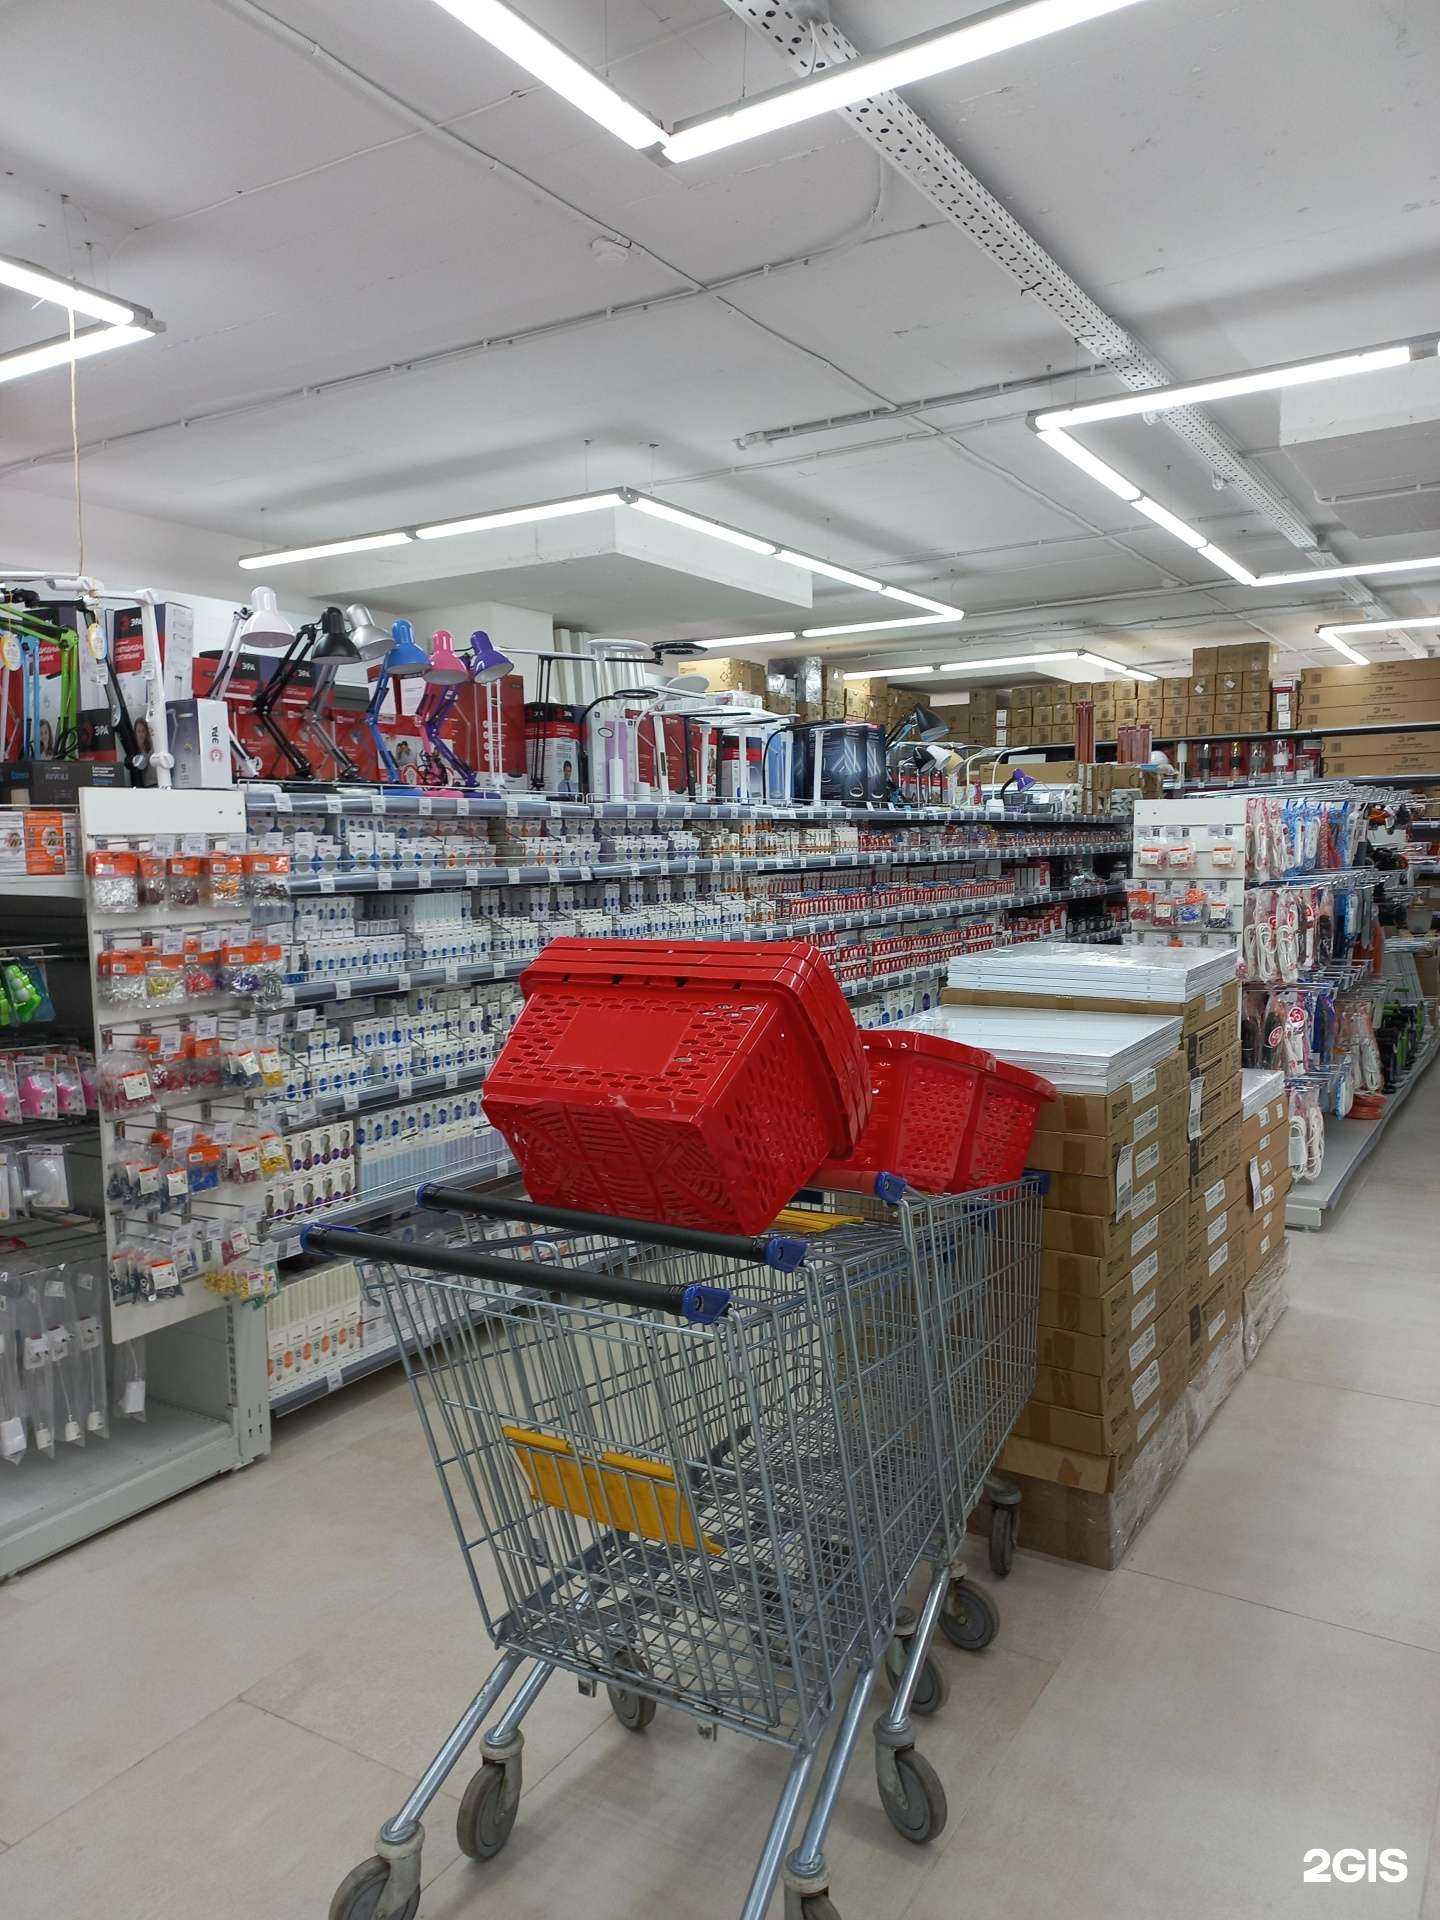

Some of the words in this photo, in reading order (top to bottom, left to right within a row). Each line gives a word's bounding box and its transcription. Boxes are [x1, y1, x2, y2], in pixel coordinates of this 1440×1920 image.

[241, 662, 256, 672] ЭРА
[94, 725, 110, 736] ЭРА
[210, 725, 220, 745] ЭРА
